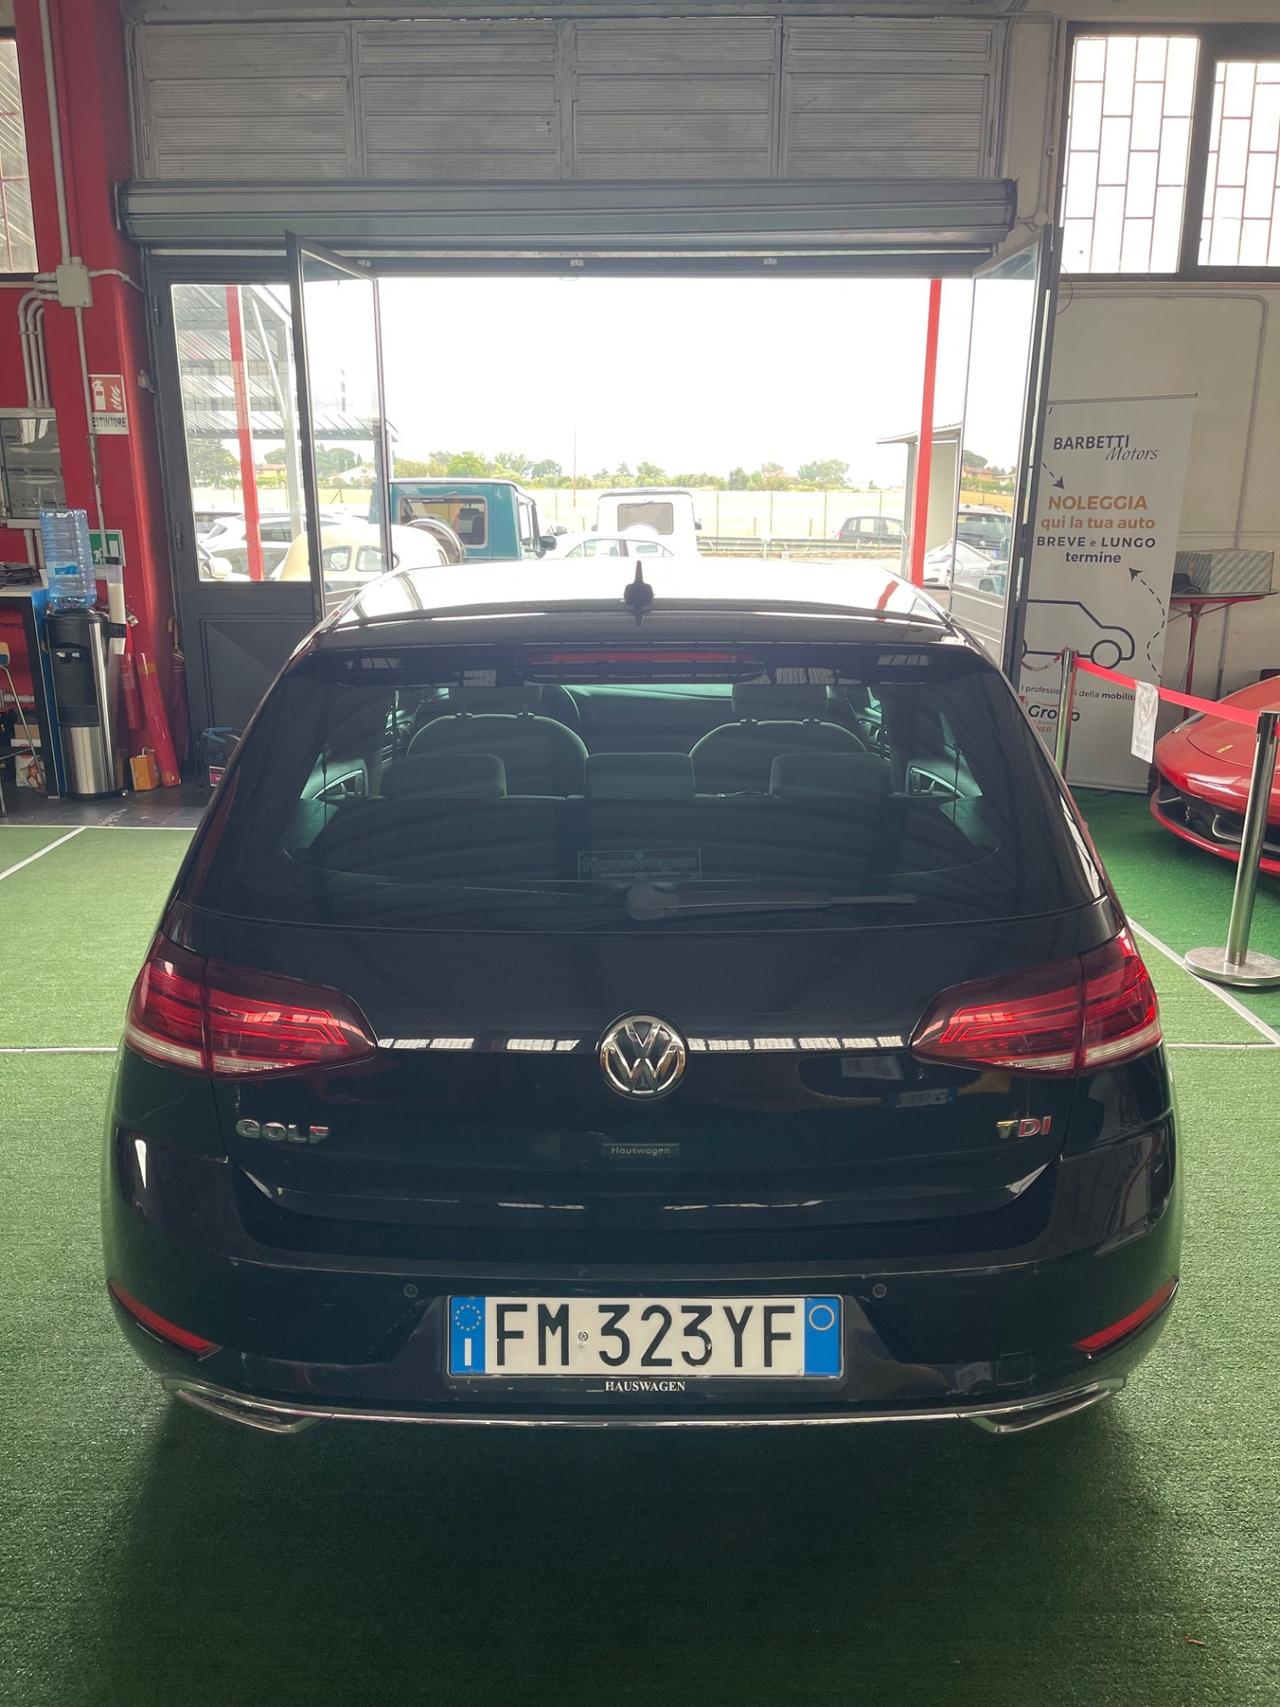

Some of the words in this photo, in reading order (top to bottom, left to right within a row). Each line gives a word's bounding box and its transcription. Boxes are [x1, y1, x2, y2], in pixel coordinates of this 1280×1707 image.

[92, 416, 126, 428] ESTINTORE
[1053, 435, 1130, 450] BARBETTI
[1105, 446, 1159, 462] Motors
[1047, 495, 1148, 511] NOLEGGIA
[1040, 516, 1066, 531] qui
[1070, 515, 1083, 529] la
[1087, 517, 1114, 529] tua
[1117, 517, 1156, 529] auto
[1036, 536, 1086, 548] BREVE
[1090, 539, 1097, 547] e
[1101, 536, 1156, 548] LUNGO
[1065, 551, 1122, 564] termine
[1078, 689, 1100, 699] della
[235, 1119, 330, 1144] GOLF
[996, 1116, 1052, 1139] TDI
[605, 1380, 686, 1393] HAUSWAGEN
